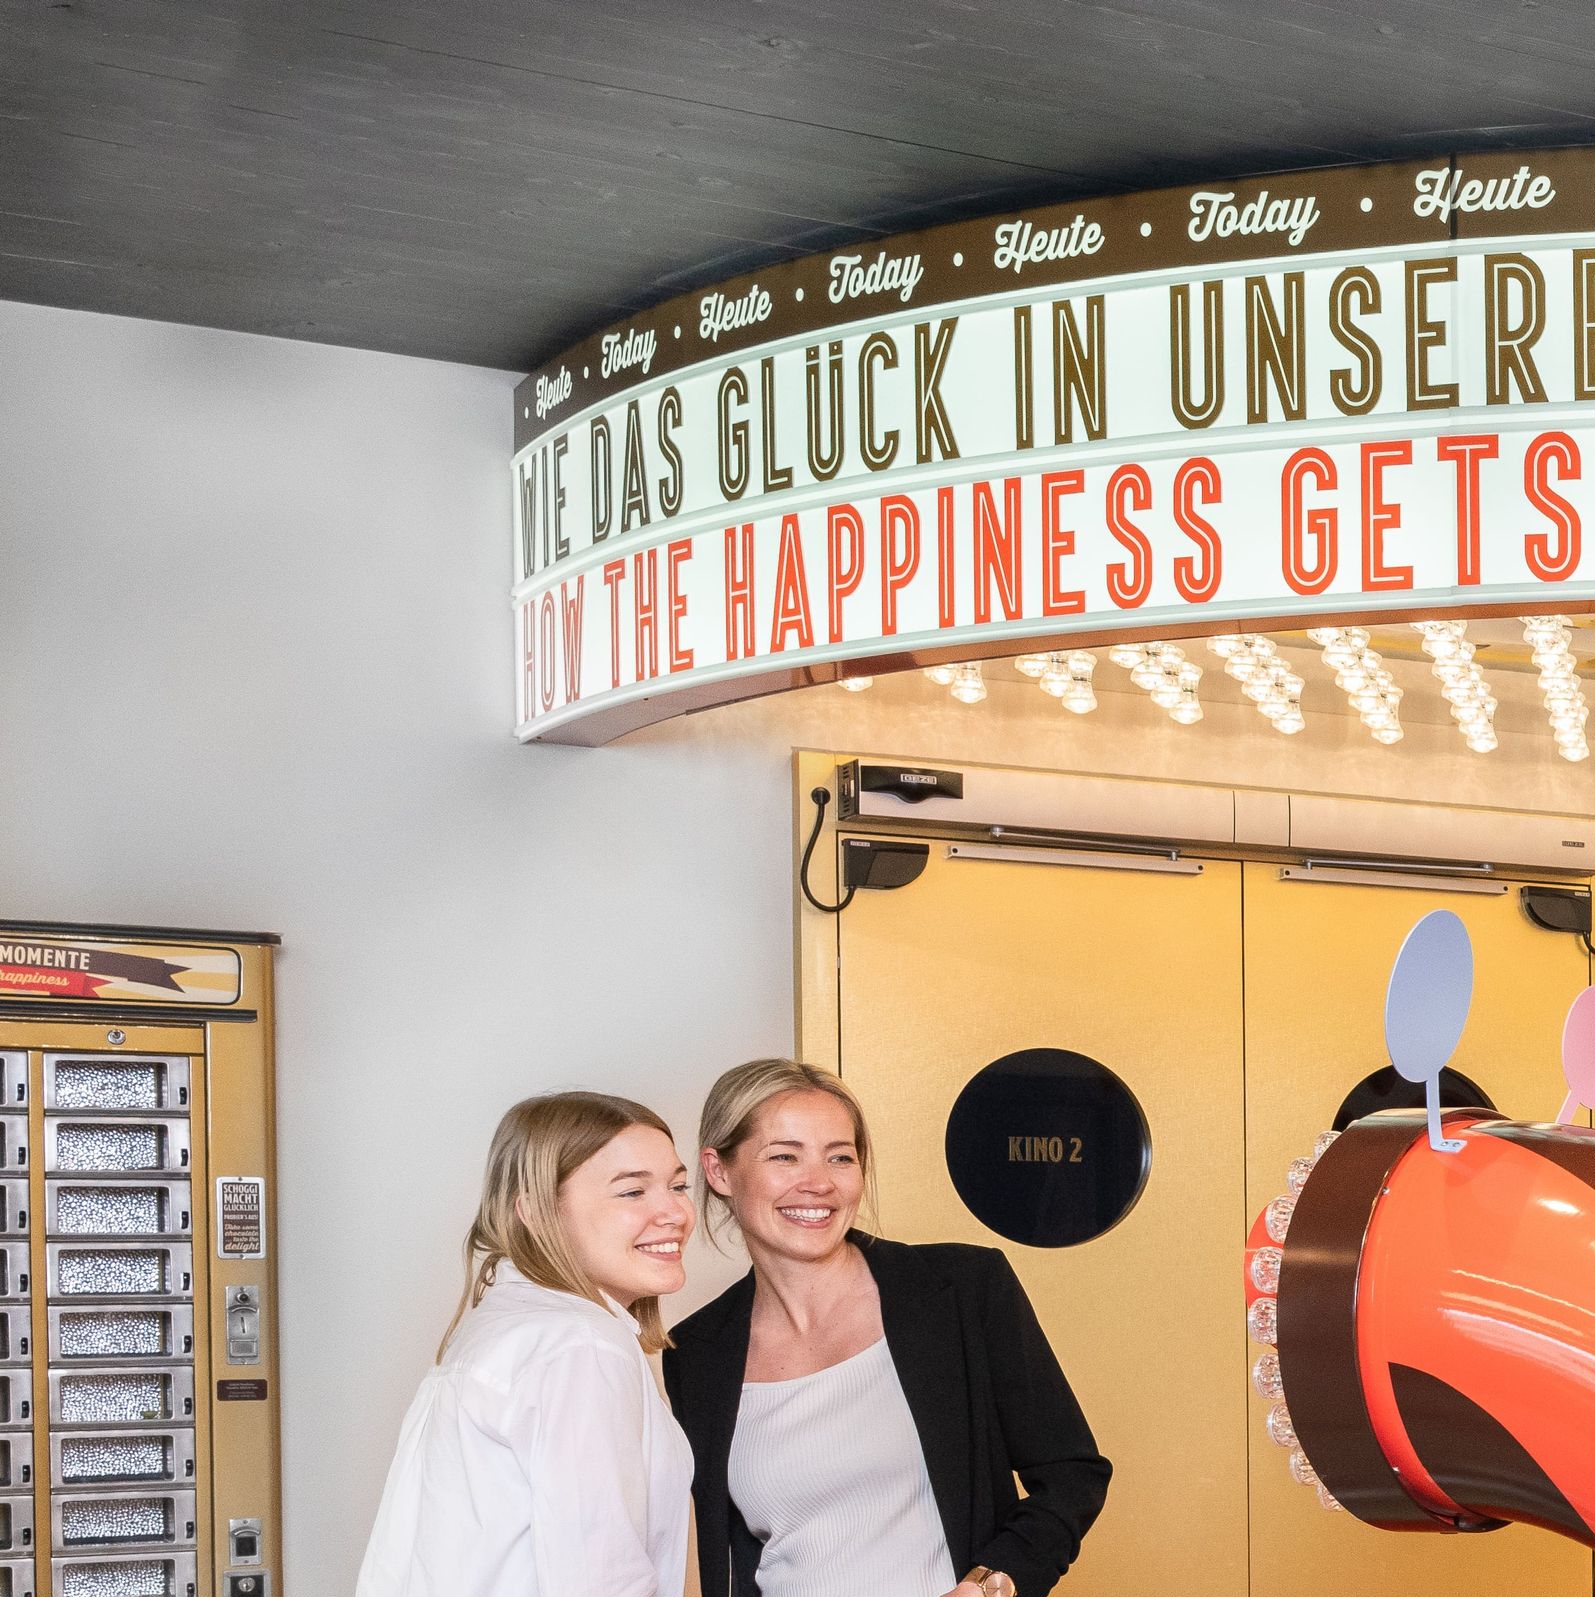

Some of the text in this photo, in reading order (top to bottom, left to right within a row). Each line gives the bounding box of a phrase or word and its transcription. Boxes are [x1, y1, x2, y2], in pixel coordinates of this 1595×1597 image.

[536, 366, 572, 420] Heute
[601, 324, 656, 379] Today
[700, 284, 772, 344] Heute
[829, 247, 924, 309] Today
[994, 214, 1105, 277] Heute
[1188, 192, 1320, 247] Today
[1414, 165, 1556, 224] Heute
[518, 432, 572, 581] WIE
[591, 385, 684, 547] DAS
[719, 316, 960, 502] GLÜCK
[1014, 295, 1106, 450] IN
[523, 572, 584, 724] HOW
[604, 537, 695, 689] THE
[723, 457, 1222, 663] HAPPINESS
[1281, 431, 1581, 595] GETS
[1008, 1136, 1083, 1163] KINO 2
[223, 1184, 258, 1194] SCHOGGI
[224, 1193, 258, 1204] MACHT
[225, 1242, 259, 1252] delight
